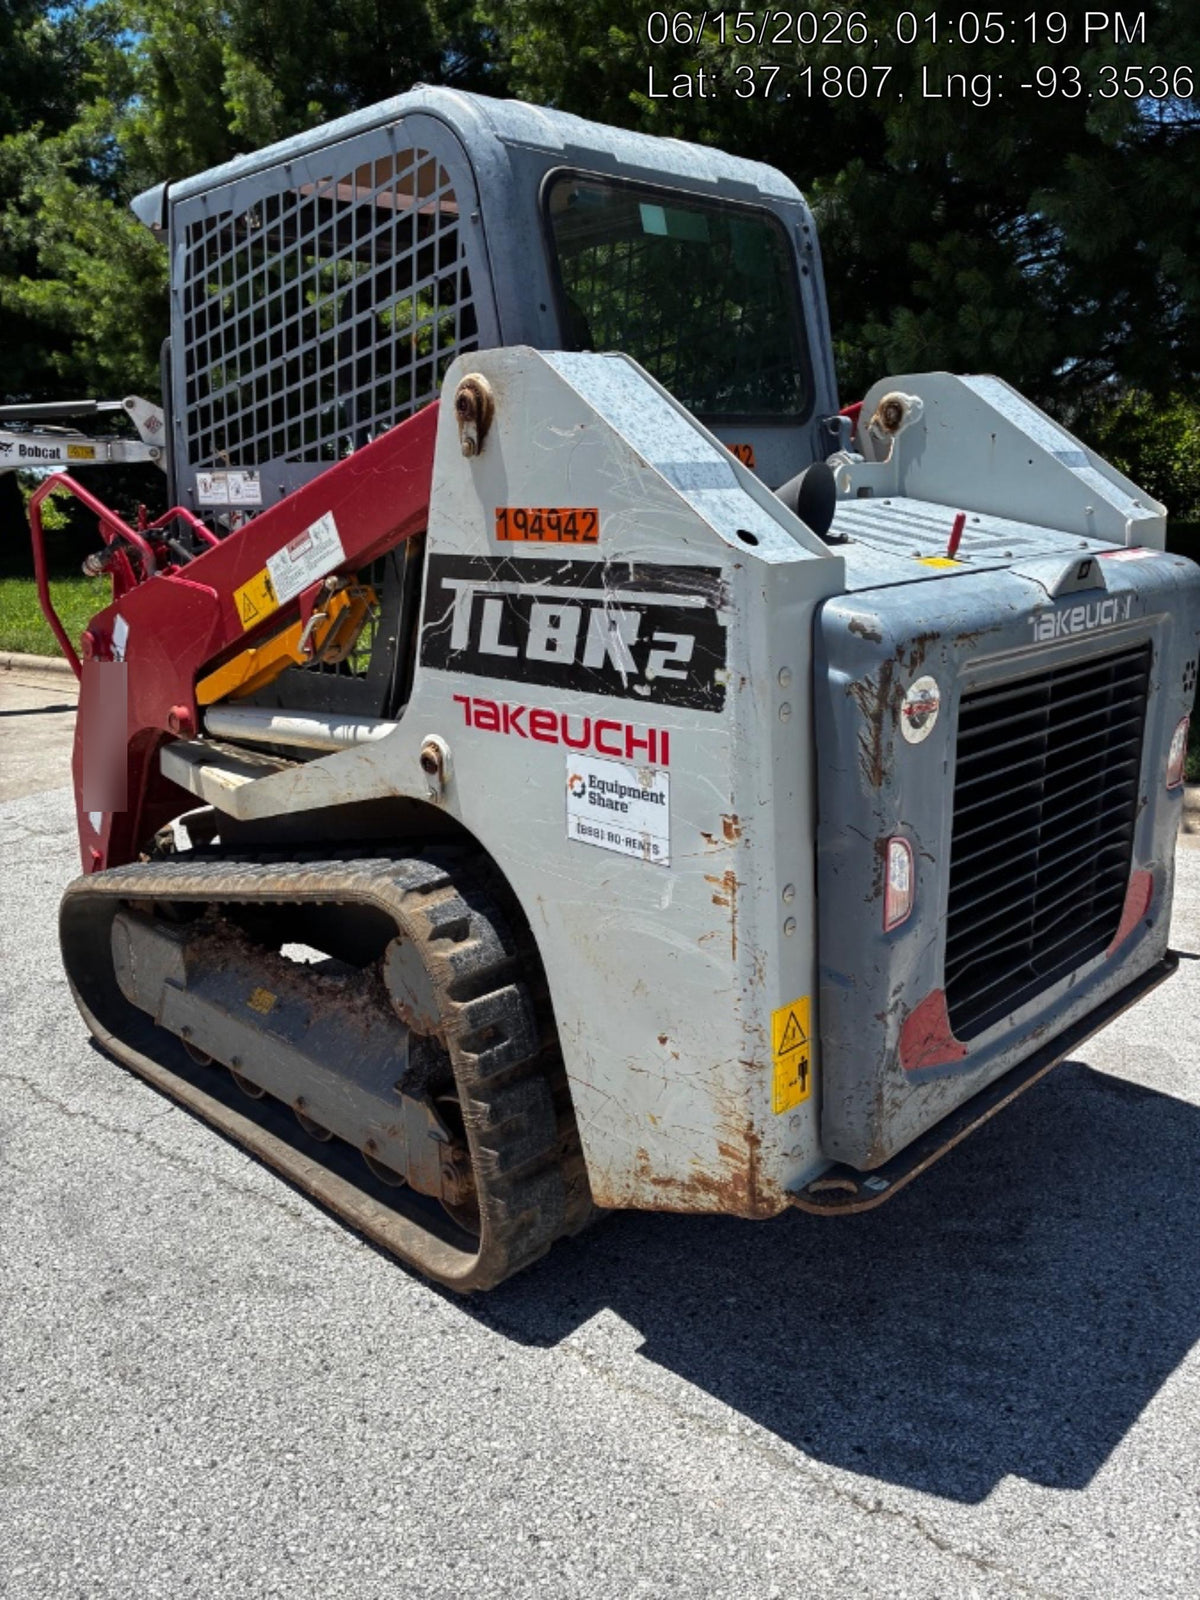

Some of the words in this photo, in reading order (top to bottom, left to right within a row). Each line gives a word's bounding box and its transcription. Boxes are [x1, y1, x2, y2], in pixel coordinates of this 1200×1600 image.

[18, 443, 61, 459] Bobcat
[497, 509, 598, 542] 194942
[588, 774, 666, 806] Equipment
[588, 791, 629, 813] Share
